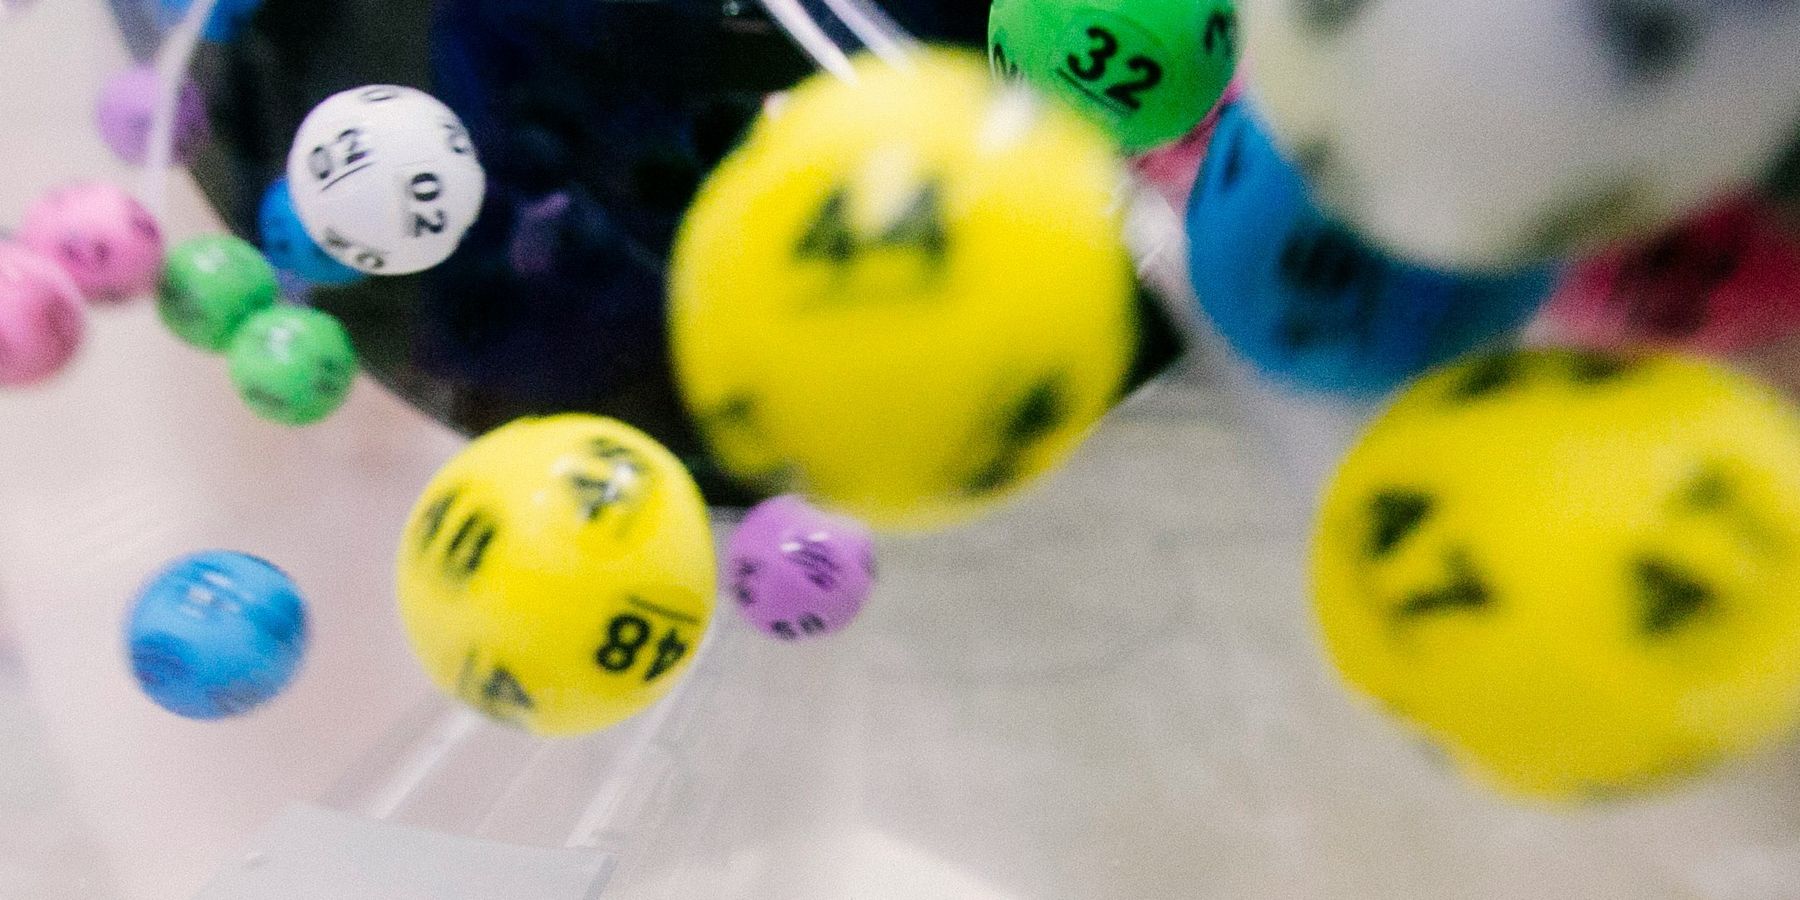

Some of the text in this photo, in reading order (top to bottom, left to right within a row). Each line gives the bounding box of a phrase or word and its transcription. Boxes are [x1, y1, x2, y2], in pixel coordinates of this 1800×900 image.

[1066, 26, 1163, 111] 32
[411, 172, 446, 238] 02
[594, 613, 688, 682] 48
